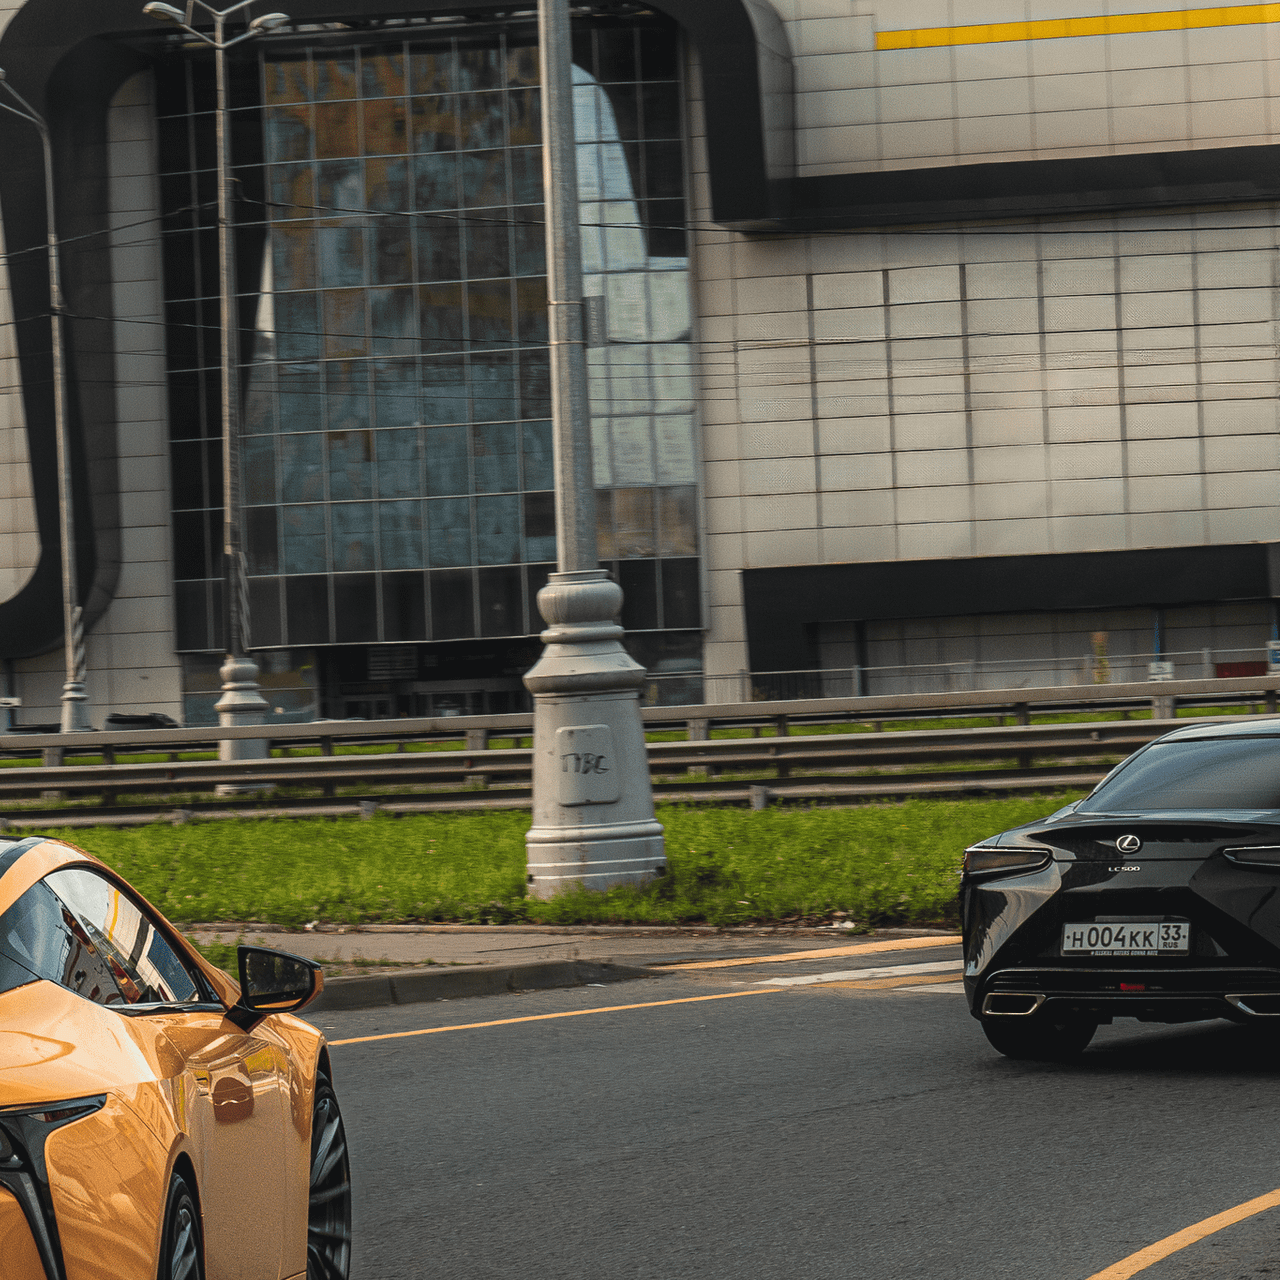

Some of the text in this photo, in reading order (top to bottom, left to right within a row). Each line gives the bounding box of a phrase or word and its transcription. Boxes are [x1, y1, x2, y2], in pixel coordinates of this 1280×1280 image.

[1072, 926, 1154, 948] Н004КК
[1160, 924, 1182, 941] 33
[1162, 941, 1179, 949] RUS
